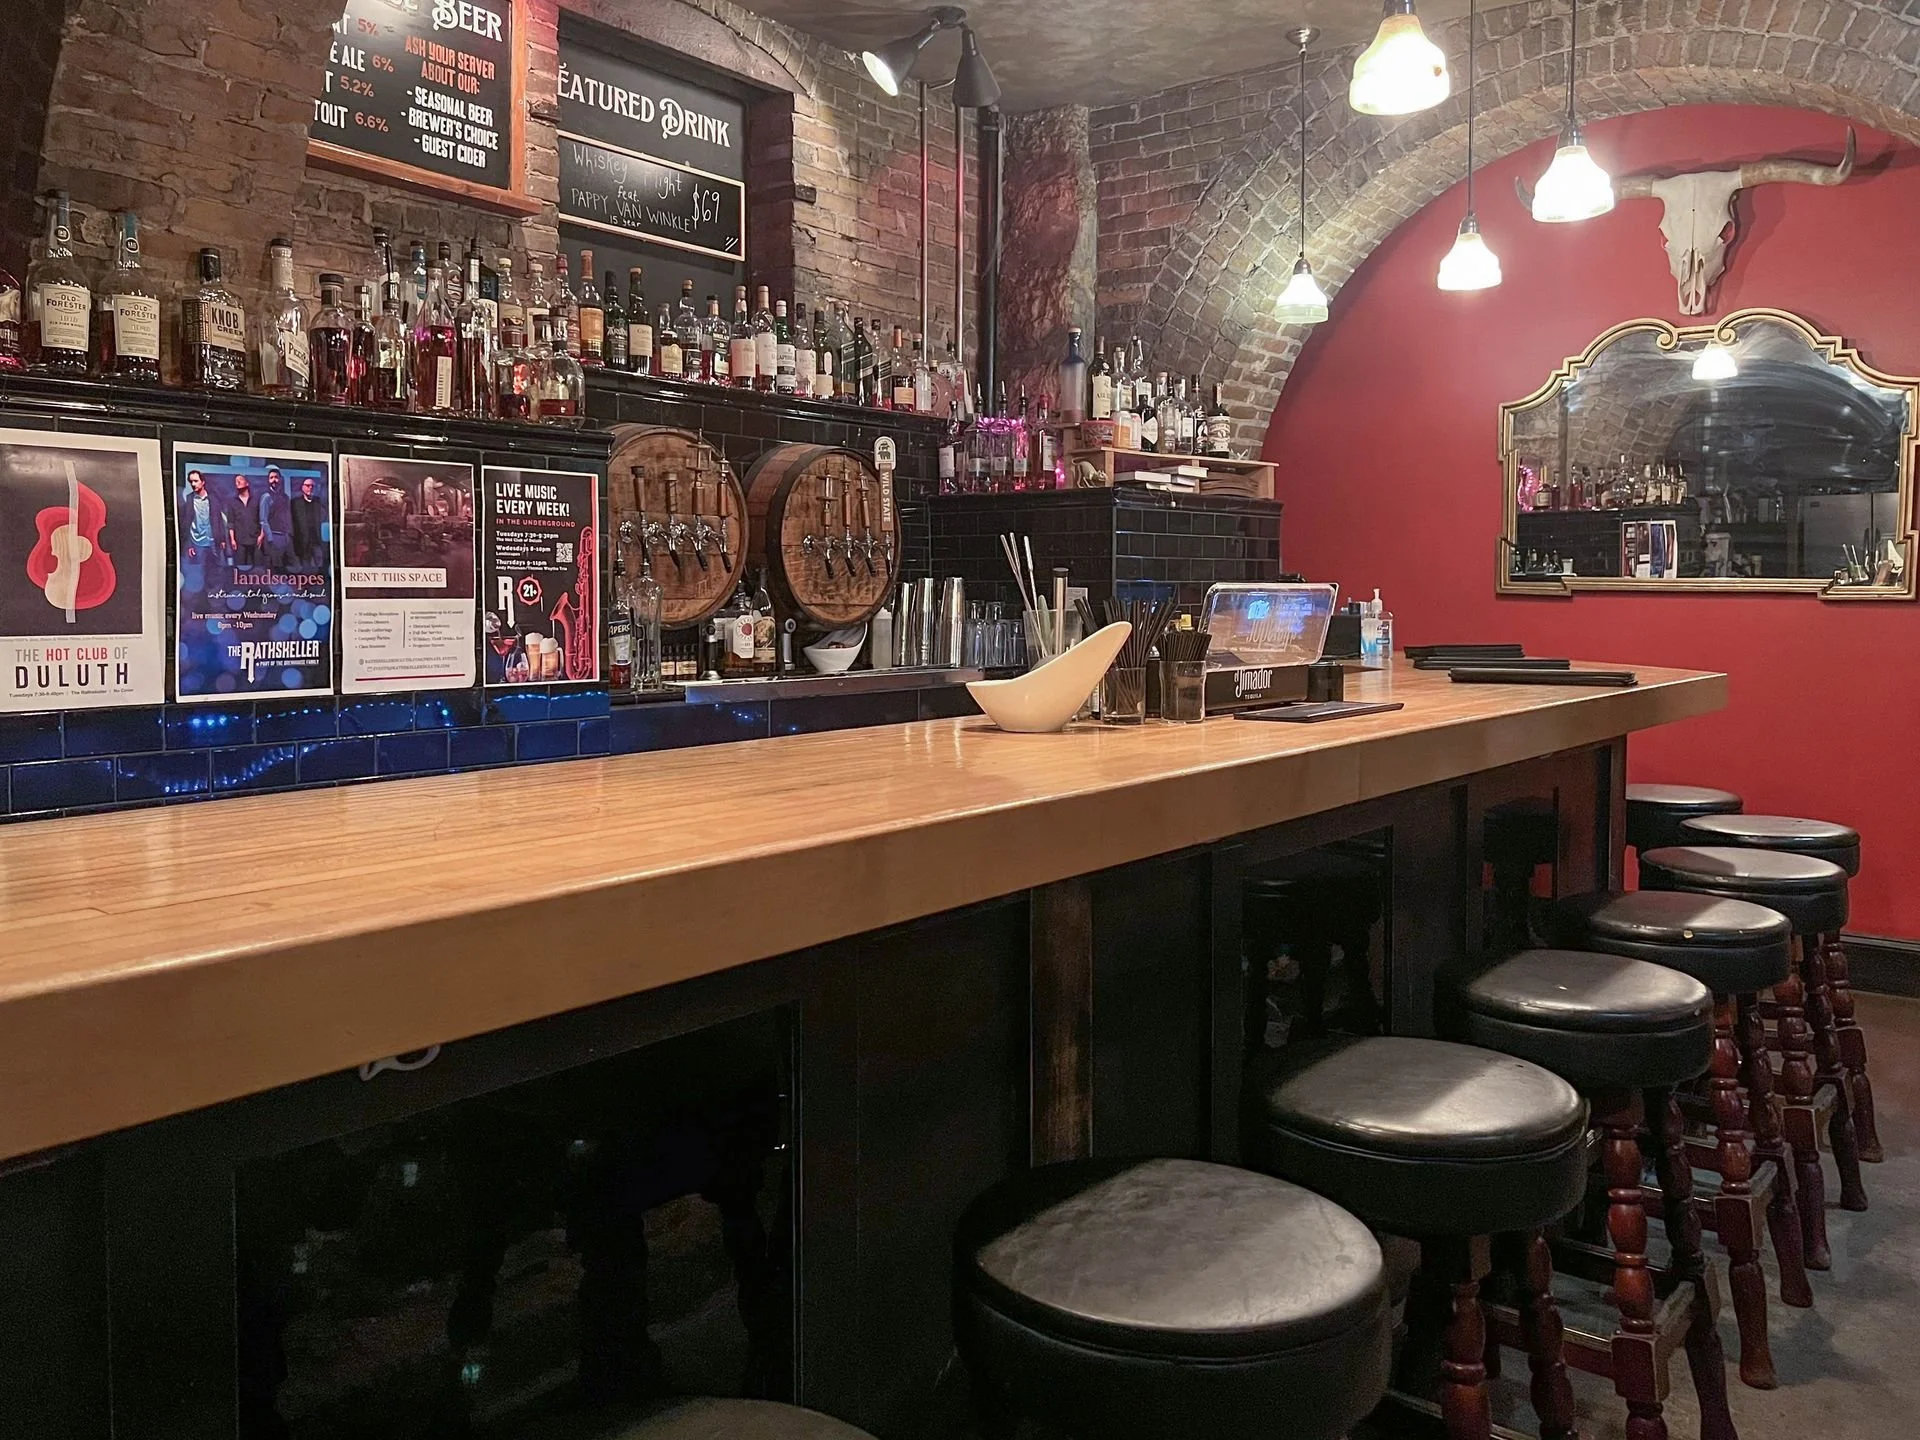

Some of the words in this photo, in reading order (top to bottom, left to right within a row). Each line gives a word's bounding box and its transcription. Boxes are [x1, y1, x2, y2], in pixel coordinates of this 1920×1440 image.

[357, 17, 379, 36] 5%
[432, 0, 503, 42] BEER
[341, 45, 366, 72] ALE
[372, 54, 394, 73] 6%
[428, 41, 456, 68] YOUR
[457, 51, 495, 81] SERVER
[340, 75, 375, 98] 5.2%
[421, 60, 456, 88] ABOUT
[457, 72, 480, 95] OUR:
[415, 85, 467, 119] SEASONAL
[468, 103, 494, 128] BEER
[556, 64, 655, 123] EATURED
[659, 97, 731, 148] DRINK
[354, 111, 390, 133] 6.6%
[408, 106, 463, 140] BREWER'S
[463, 123, 500, 151] CHOICE
[421, 133, 457, 160] GUEST
[457, 143, 487, 168] CIDER
[573, 143, 628, 184] Whiskey
[571, 188, 609, 214] PAPPY
[615, 199, 642, 220] VAN
[645, 205, 690, 233] WINKLE
[617, 185, 640, 202] feat.
[691, 183, 720, 230] $69
[609, 214, 618, 225] 15
[46, 298, 87, 311] FORESTER
[60, 294, 76, 302] OLD
[133, 304, 148, 312] OLD
[120, 308, 157, 320] FORESTER
[211, 307, 239, 329] KNOB
[496, 482, 522, 498] LIVE
[524, 484, 557, 500] MUSIC
[881, 471, 890, 495] WILD
[496, 499, 533, 515] EVERY
[536, 502, 570, 517] WEEK!
[882, 497, 891, 523] STATE
[522, 519, 576, 528] UNDERGROUND
[496, 531, 523, 539] Tuesdays
[496, 559, 526, 567] Thursdays
[233, 569, 325, 590] landscapes
[350, 572, 379, 582] RENT
[382, 572, 406, 582] THIS
[408, 573, 443, 582] SPACE
[522, 584, 538, 597] 21+
[15, 649, 40, 662] THE
[45, 648, 70, 661] HOT
[77, 647, 108, 660] CLUB
[114, 647, 129, 660] OF
[228, 646, 241, 657] THE
[15, 663, 128, 689] DULUTH
